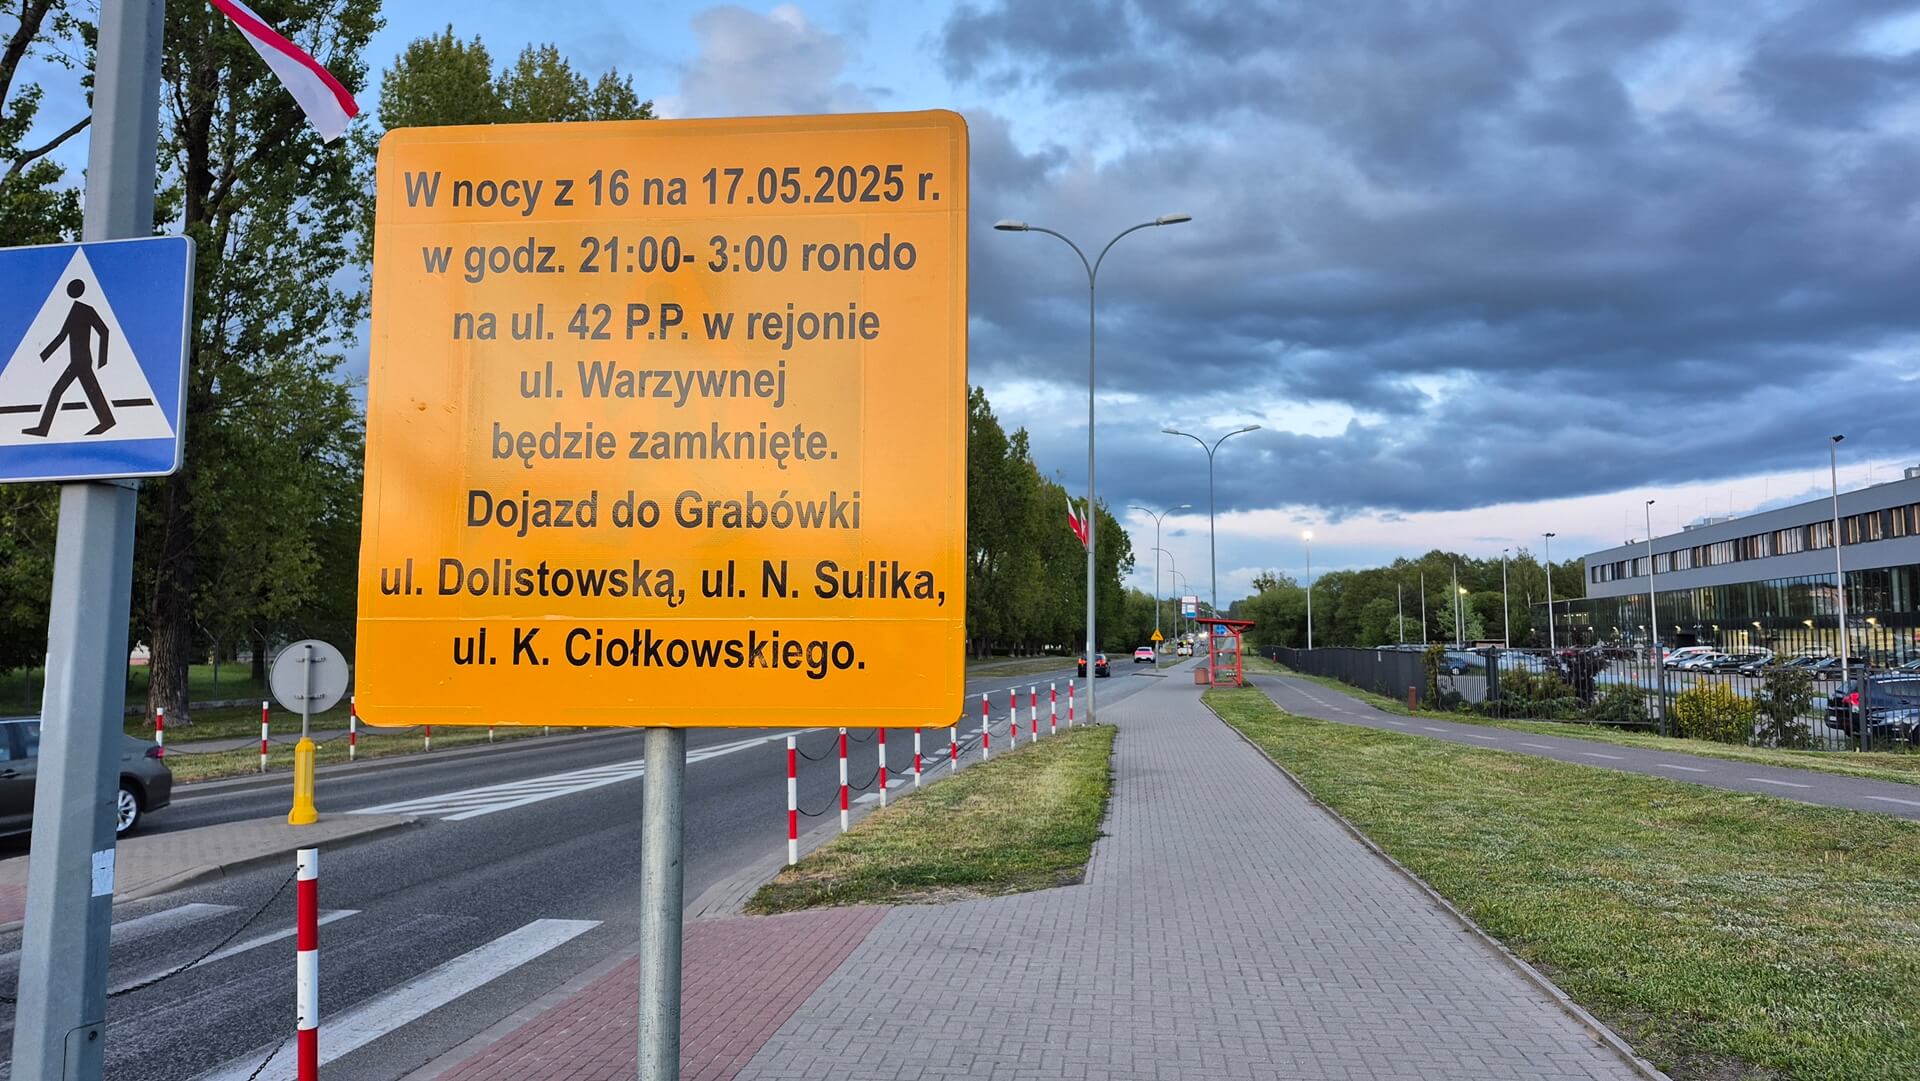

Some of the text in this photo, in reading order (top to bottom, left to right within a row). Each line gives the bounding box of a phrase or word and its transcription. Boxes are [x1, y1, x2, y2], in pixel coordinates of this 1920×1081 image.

[404, 164, 940, 217] W nocy z 16 na 17.05.2025 r.
[422, 232, 917, 284] w godz. 21:00- 3:00 rondo
[453, 302, 881, 351] na ul. 42 P.P. w rejonie
[520, 359, 786, 409] ul. Warzywnej
[492, 421, 838, 471] będzie zamknięte.
[467, 489, 861, 538] Dojazd do Grabówki
[380, 557, 946, 609] ul. Dolistowską, ul. N. Sulika,
[453, 626, 866, 681] ul. K. Ciołkowskiego.
